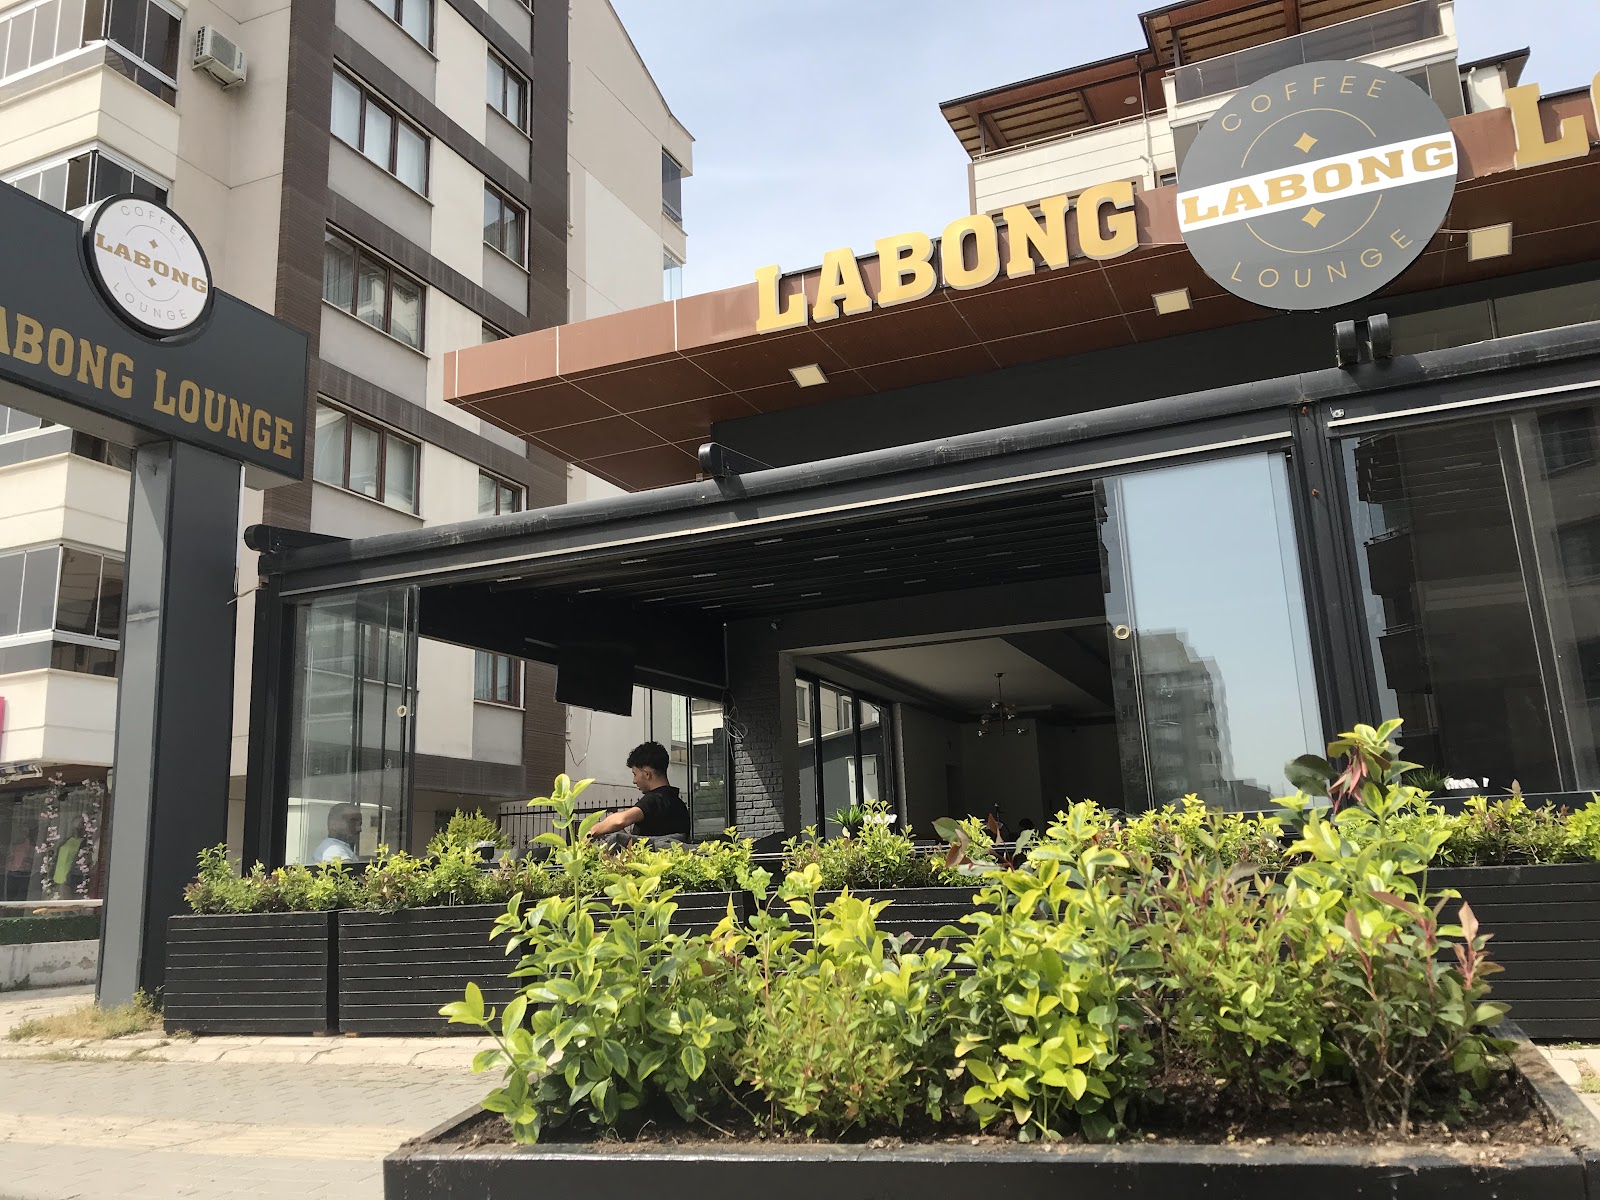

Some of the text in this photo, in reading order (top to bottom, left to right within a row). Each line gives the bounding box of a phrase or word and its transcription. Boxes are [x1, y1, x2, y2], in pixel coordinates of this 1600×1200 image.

[1221, 75, 1387, 133] COFFEE
[754, 70, 1600, 335] LABONG L
[1181, 140, 1454, 226] LABONG
[120, 205, 189, 246] COFFEE
[95, 232, 207, 294] LABONG
[1230, 228, 1414, 289] LOUNGE
[113, 281, 188, 321] LOUNGE
[153, 368, 293, 459] LOUNGE
